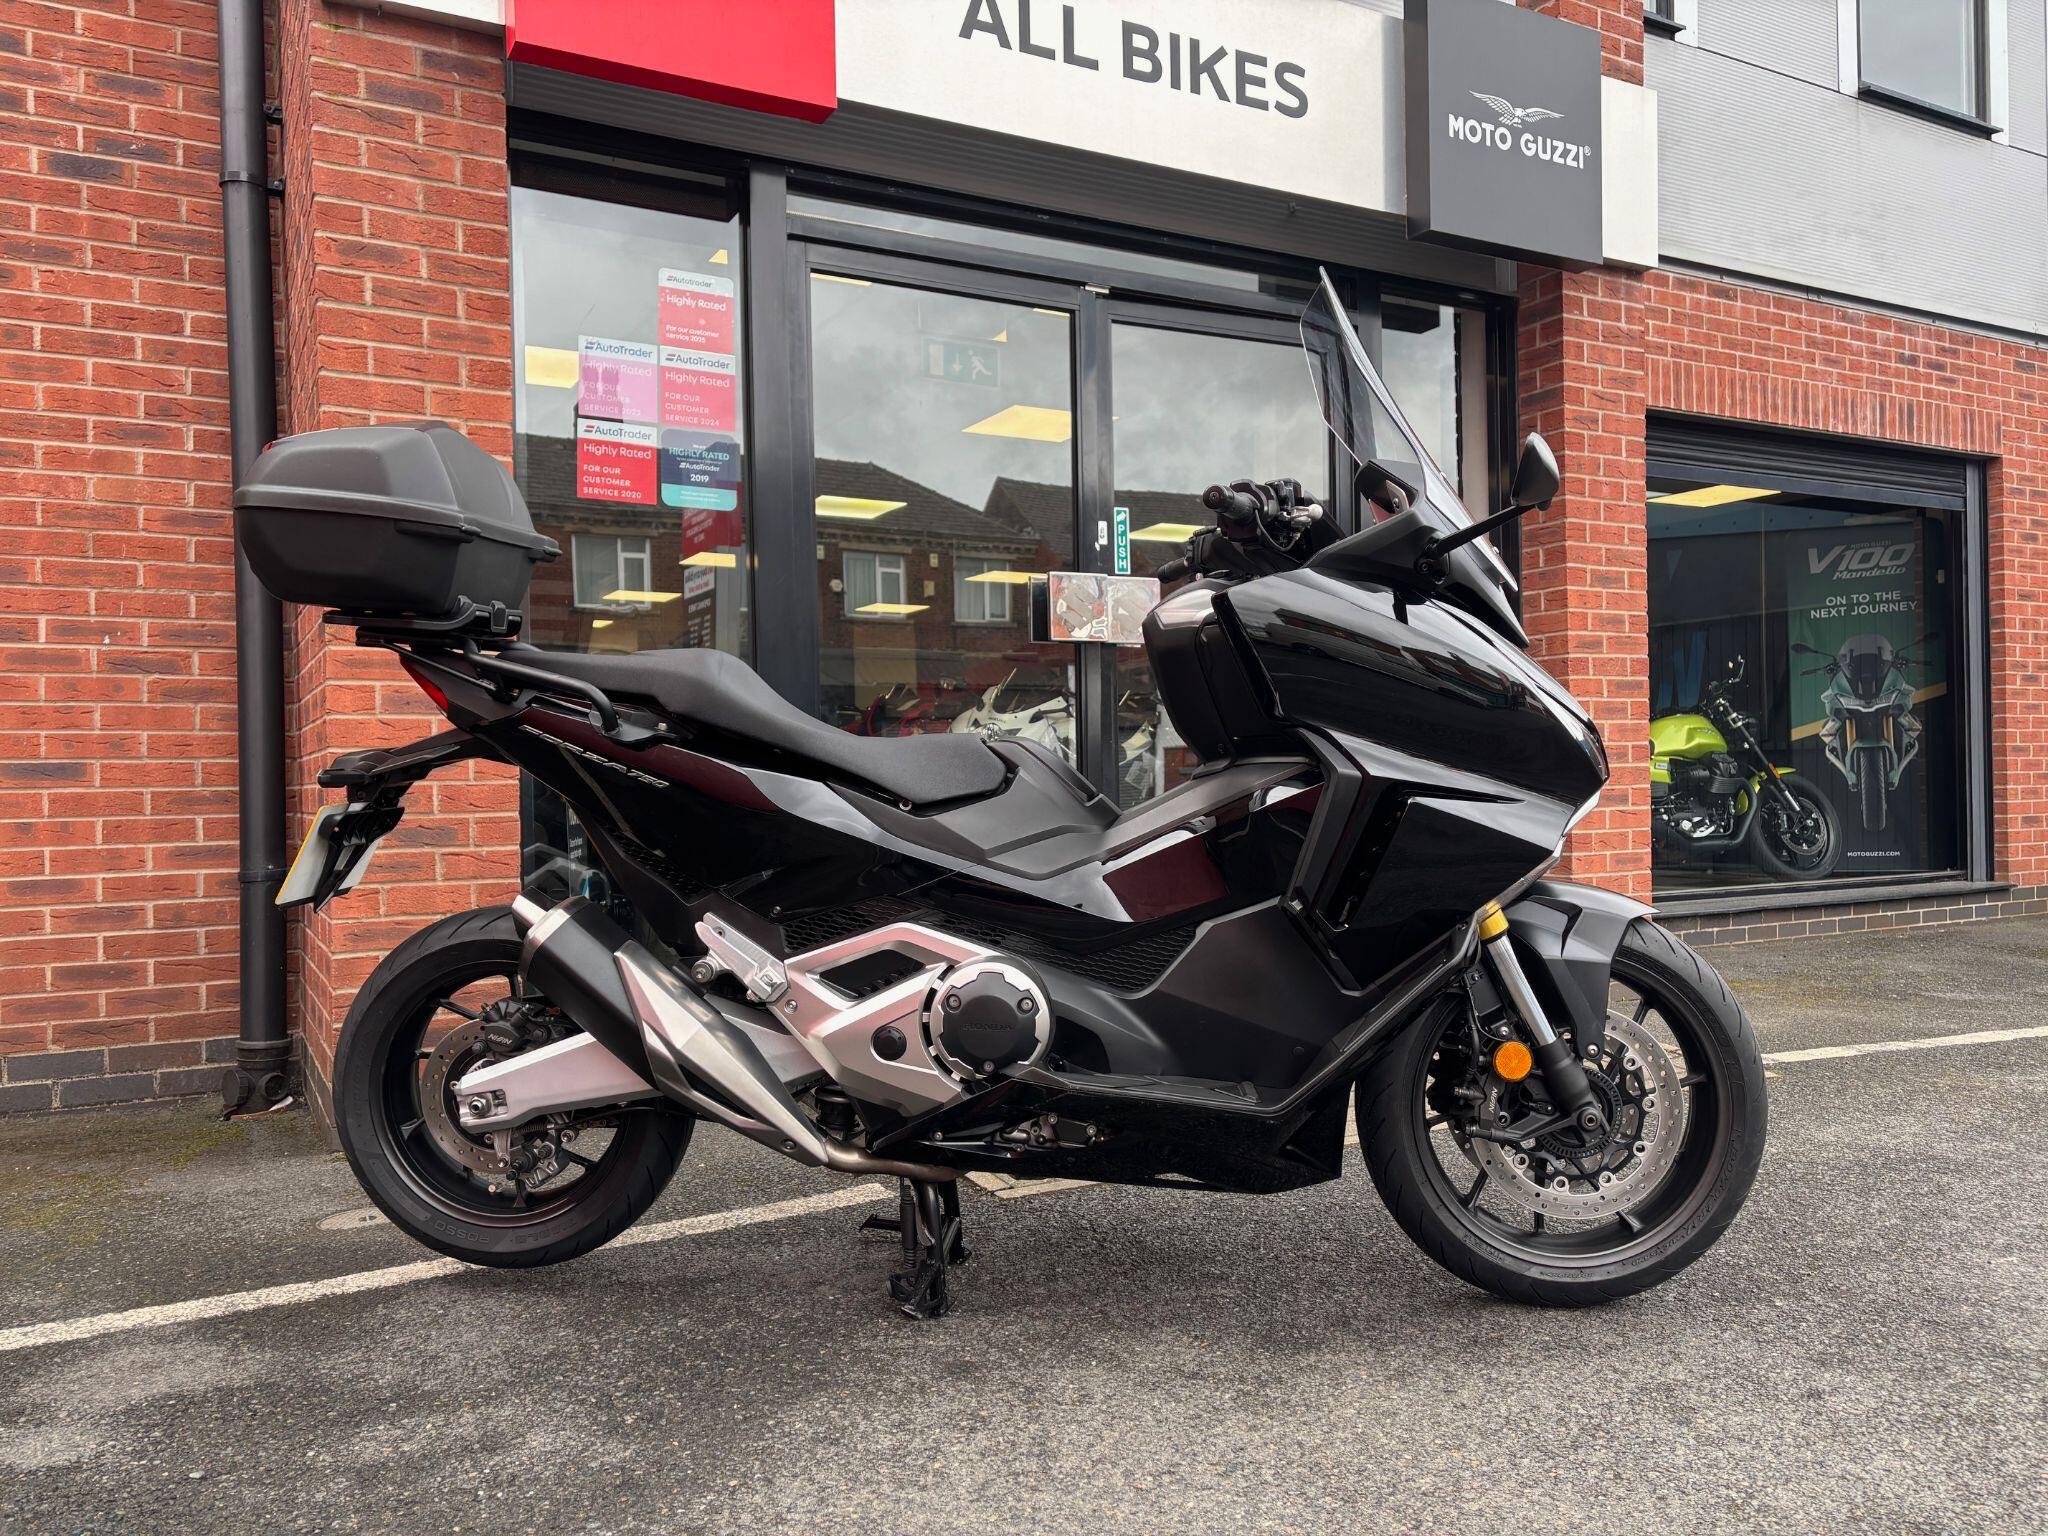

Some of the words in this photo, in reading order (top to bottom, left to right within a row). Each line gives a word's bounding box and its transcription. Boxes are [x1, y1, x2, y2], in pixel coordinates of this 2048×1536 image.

[958, 0, 1099, 71] ALL
[1121, 19, 1309, 119] BIKES
[1448, 113, 1512, 151] MOTO
[673, 276, 713, 288] Autotrader
[666, 294, 697, 309] Highly
[698, 299, 727, 311] Rated
[665, 324, 677, 332] For
[689, 328, 720, 338] customer
[665, 332, 690, 341] service
[595, 342, 653, 358] AutoTrader
[585, 359, 618, 375] Highly
[620, 363, 652, 377] Rated
[676, 354, 731, 370] AutoTrader
[665, 370, 698, 385] Highly
[699, 374, 730, 388] Rated
[665, 391, 681, 400] FOR
[683, 393, 700, 402] OUR
[584, 403, 620, 414] SERVICE
[665, 402, 709, 414] CUSTOMER
[665, 413, 699, 424] SERVICE
[700, 417, 720, 426] 2024
[594, 425, 653, 441] AutoTrader
[583, 442, 618, 458] Highly
[619, 447, 652, 460] Rated
[669, 447, 701, 459] HIGHLY
[702, 451, 730, 461] RATED
[583, 464, 601, 472] FOR
[602, 466, 621, 475] OUR
[685, 462, 720, 473] AutoTrader
[583, 475, 631, 487] CUSTOMER
[690, 473, 709, 483] 2019
[583, 486, 619, 497] SERVICE
[621, 490, 642, 499] 2020
[1117, 525, 1127, 569] PUSH
[1807, 542, 1916, 574] V100
[1832, 566, 1906, 581] Mandello
[1825, 594, 1846, 606] ON
[1850, 593, 1870, 604] TO
[1873, 590, 1901, 601] THE
[1810, 606, 1847, 619] NEXT
[1851, 600, 1918, 616] JOURNEY
